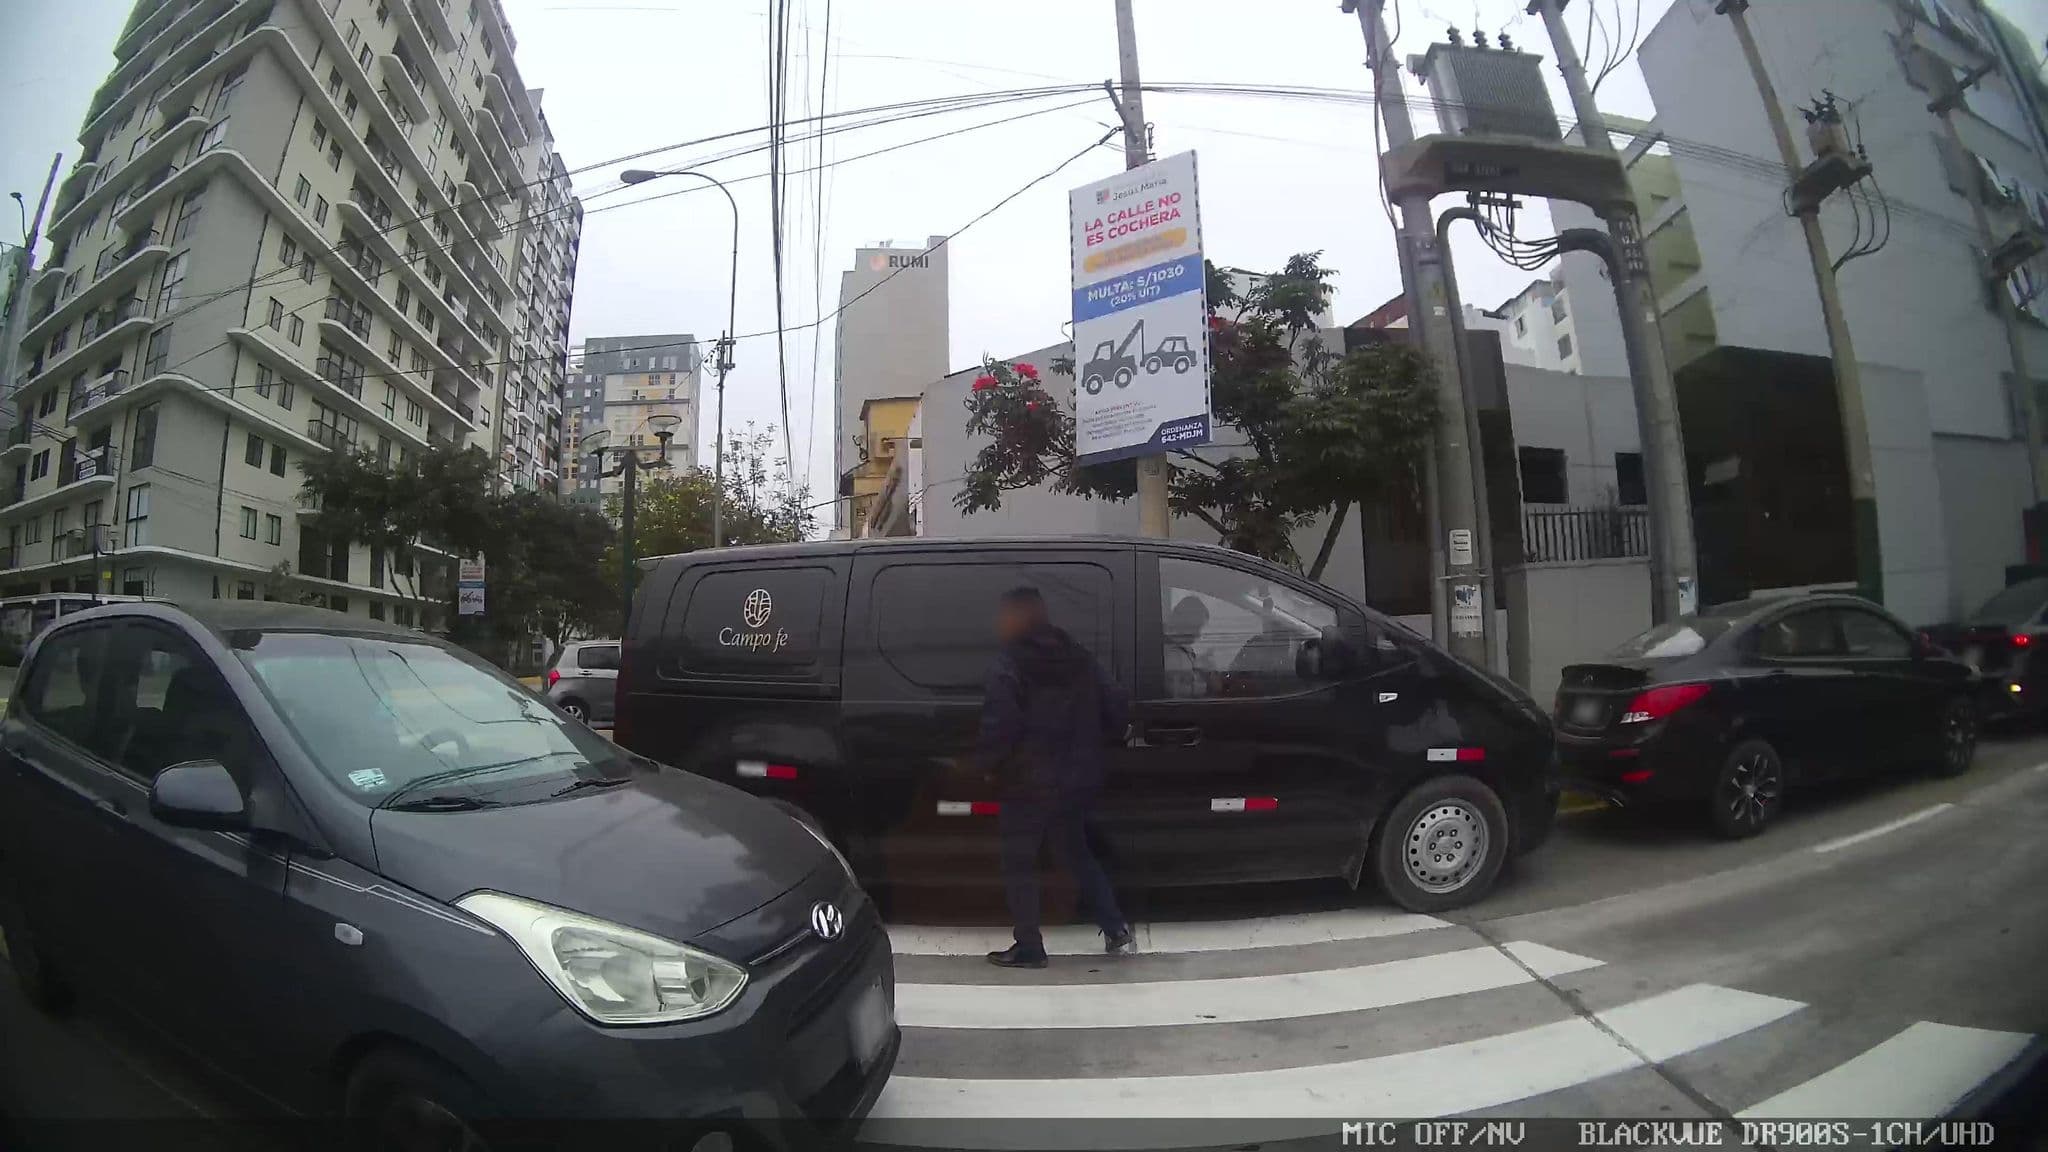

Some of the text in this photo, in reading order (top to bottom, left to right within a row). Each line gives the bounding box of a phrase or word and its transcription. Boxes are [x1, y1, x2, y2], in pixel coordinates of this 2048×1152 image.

[1084, 191, 1182, 233] LA CALLE NO
[1086, 207, 1182, 247] ES COCHERA
[889, 255, 929, 268] RUMI
[1087, 263, 1185, 302] MULTA: S/1030
[1110, 290, 1137, 307] (20%
[719, 627, 788, 653] Campo fe
